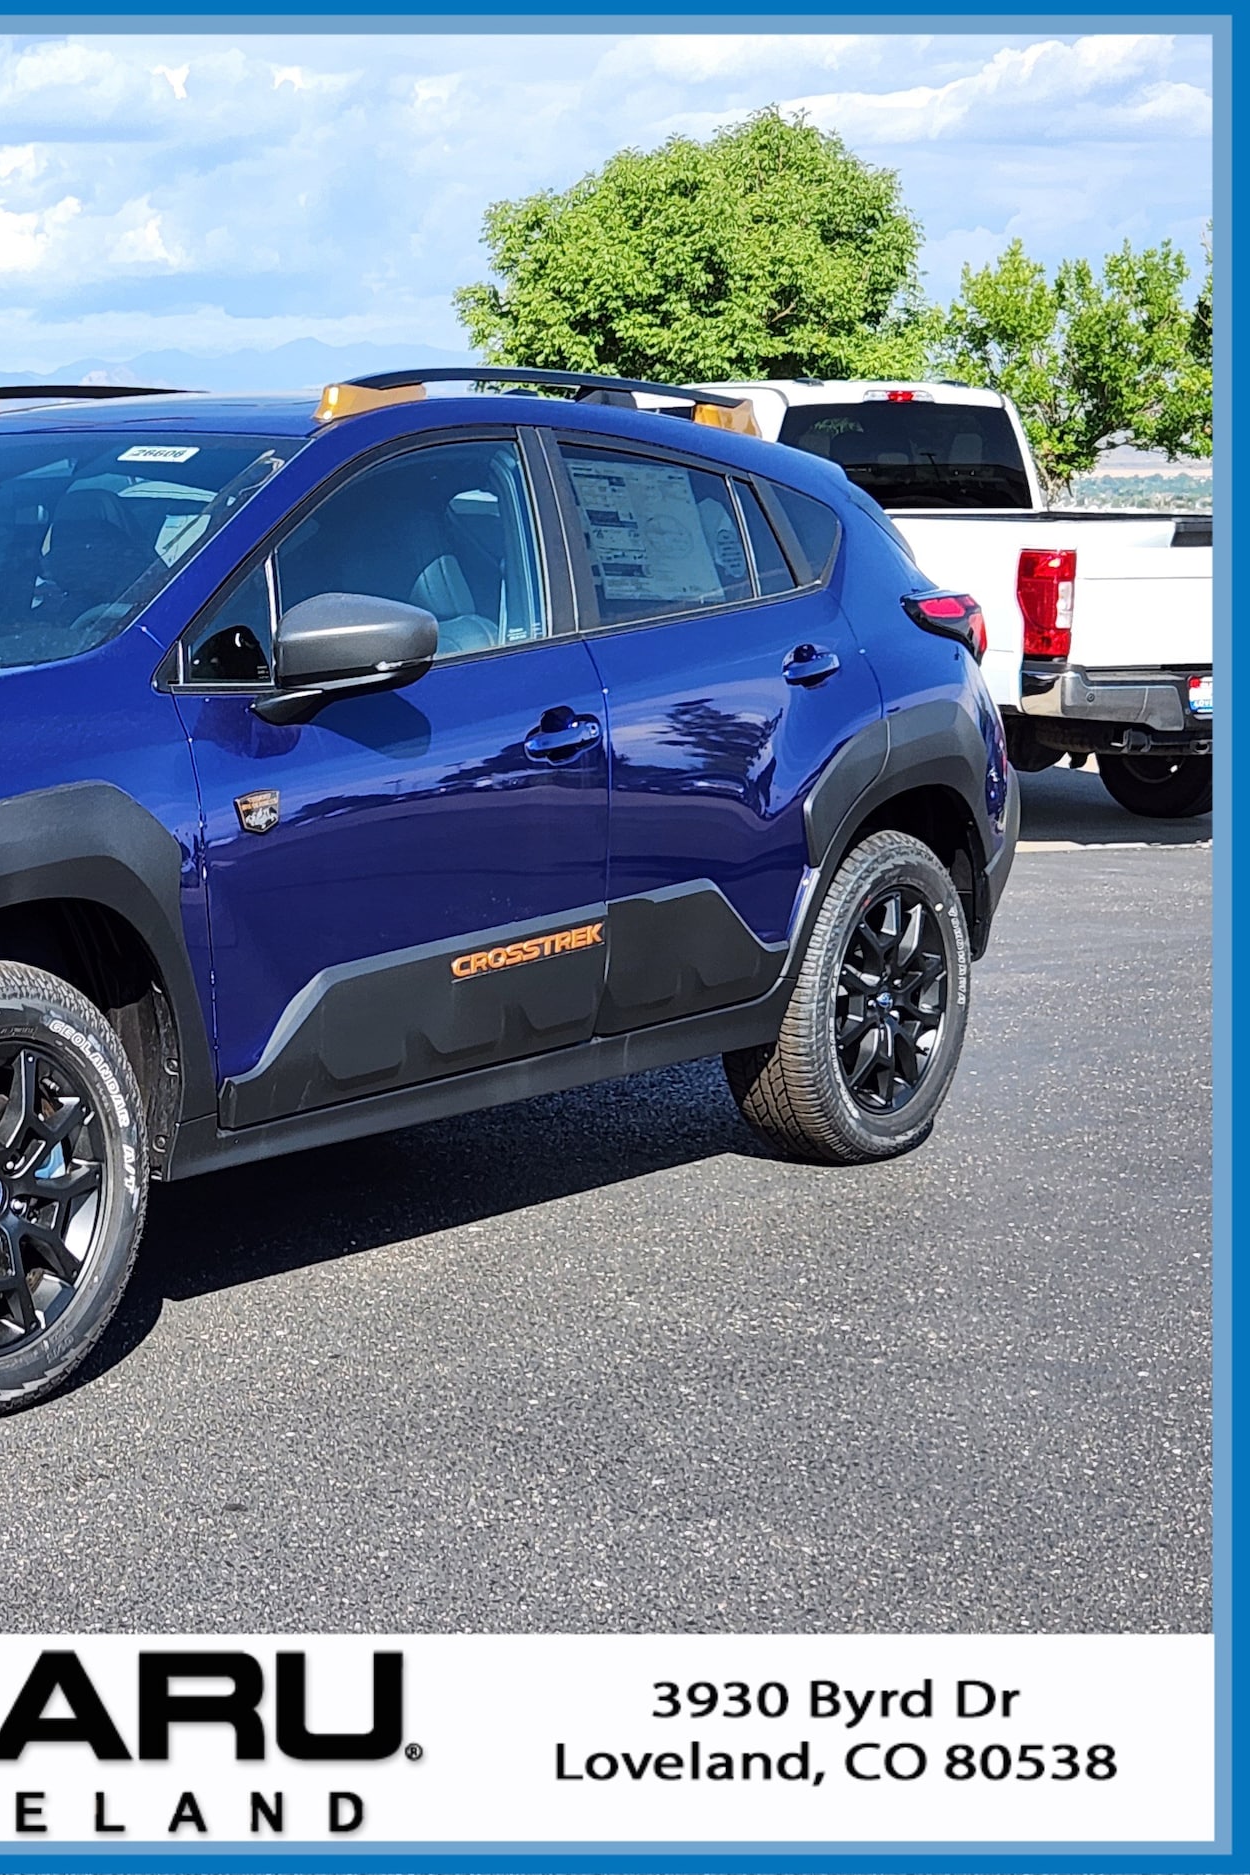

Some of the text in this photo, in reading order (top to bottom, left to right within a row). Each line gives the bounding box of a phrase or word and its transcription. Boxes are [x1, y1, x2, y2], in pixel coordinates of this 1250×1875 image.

[451, 923, 605, 977] CROSSTREK
[49, 1018, 131, 1128] GEOLANDAR
[122, 1143, 136, 1195] A/T
